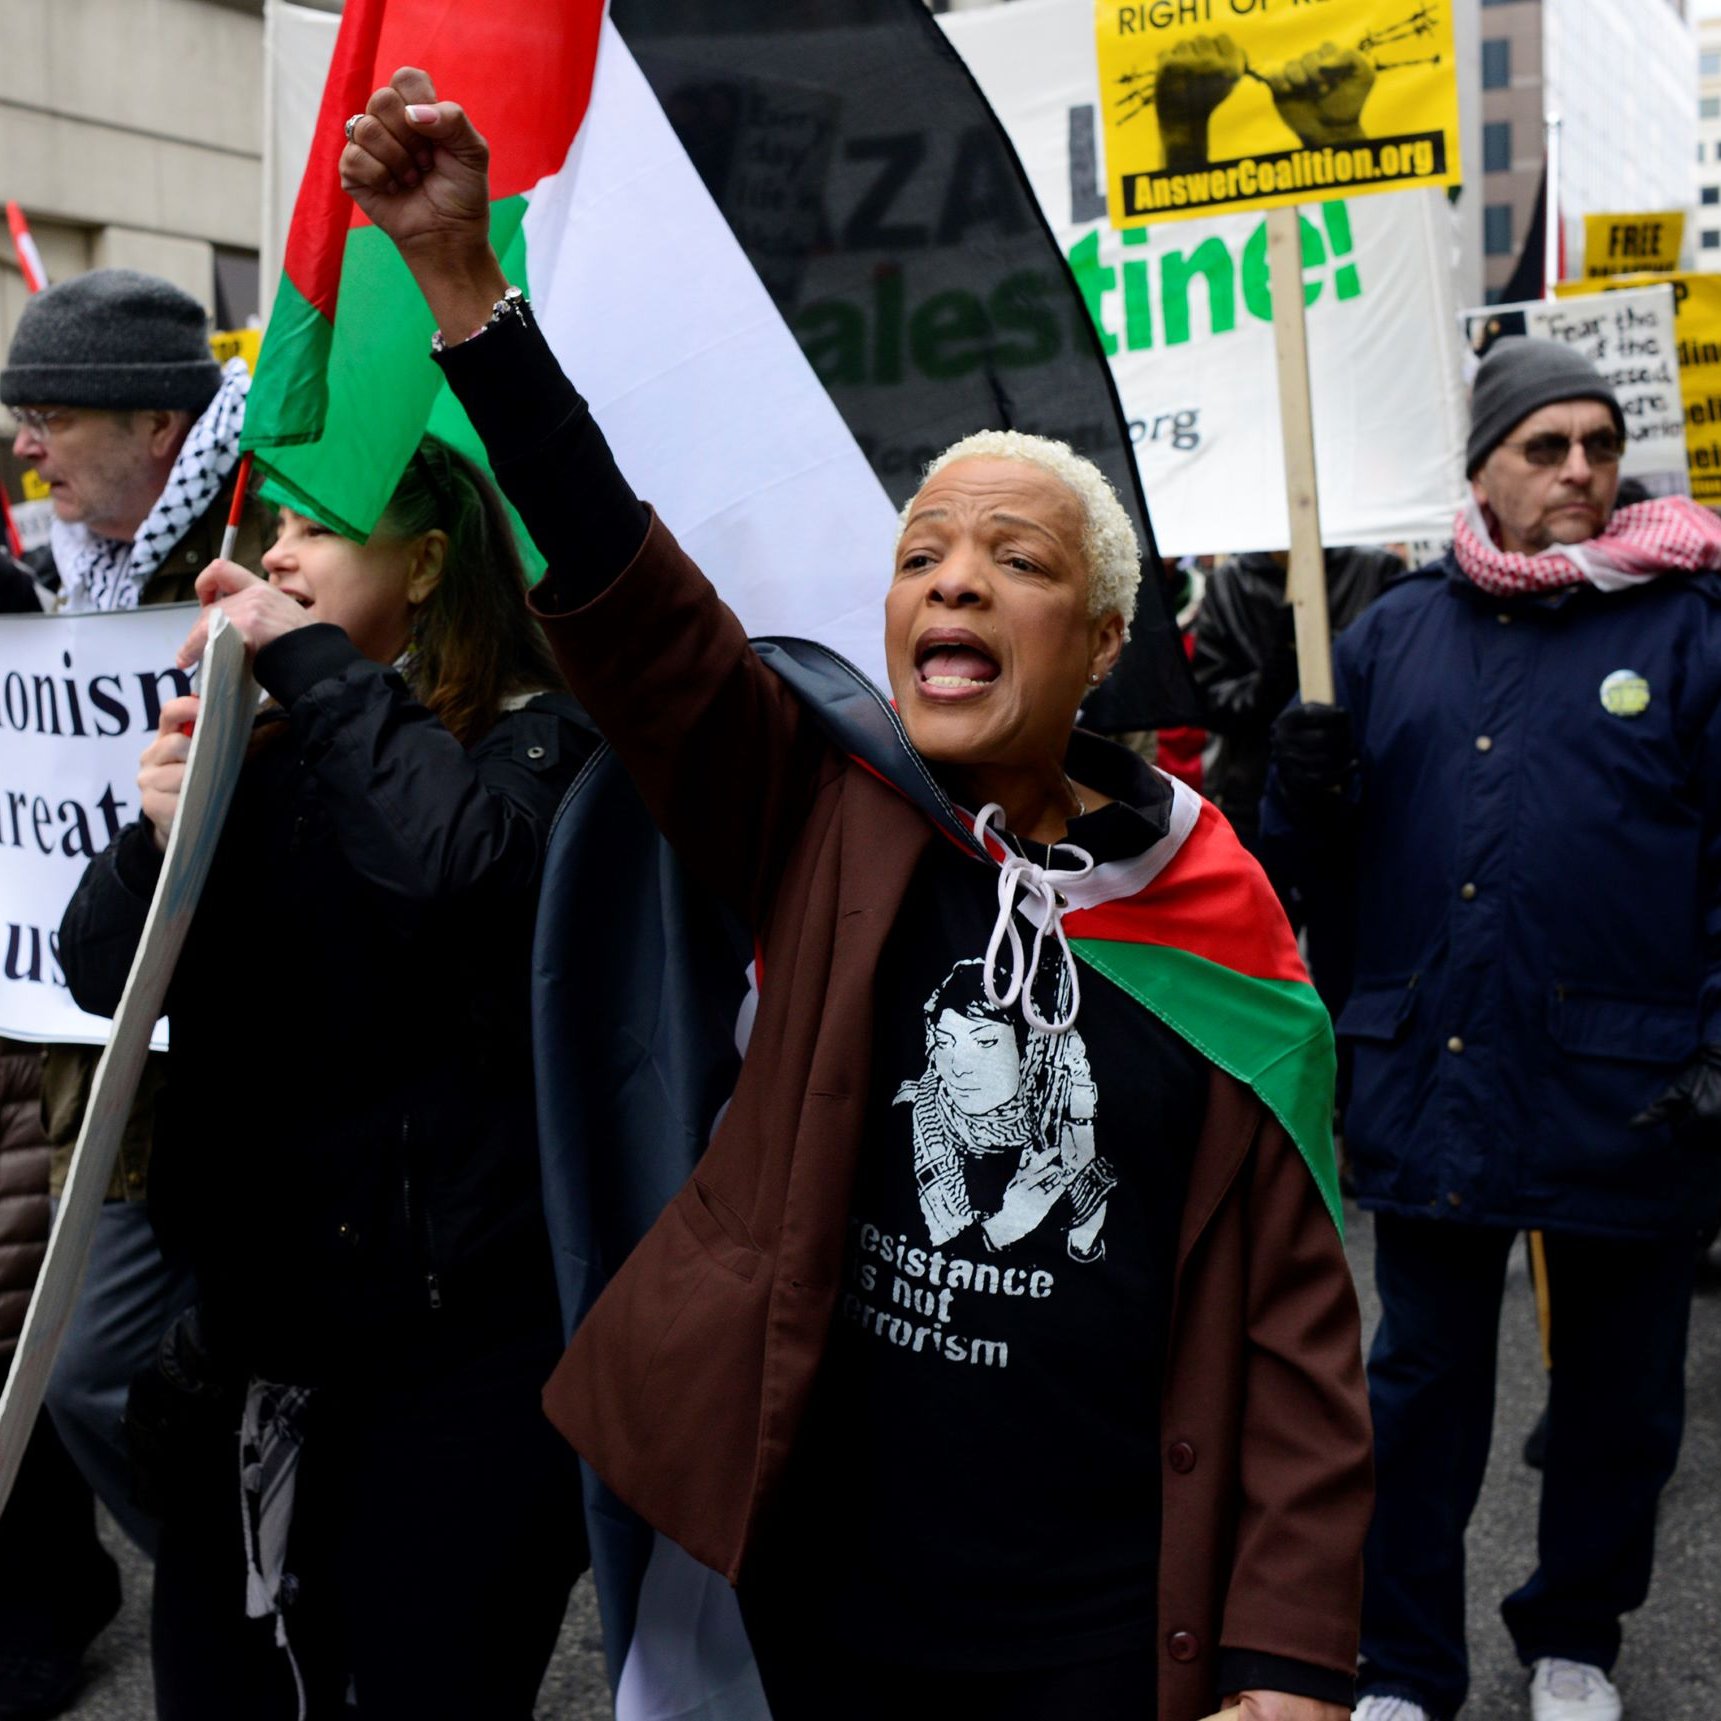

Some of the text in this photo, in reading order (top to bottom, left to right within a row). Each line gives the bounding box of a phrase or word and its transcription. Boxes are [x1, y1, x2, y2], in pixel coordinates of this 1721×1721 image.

[1118, 0, 1213, 35] RIGHT
[1133, 140, 1436, 212] AnswerCoalition.org
[1607, 222, 1663, 257] FREE
[0, 783, 127, 859] reat
[860, 1222, 1054, 1299] esistance
[892, 1275, 954, 1323] not
